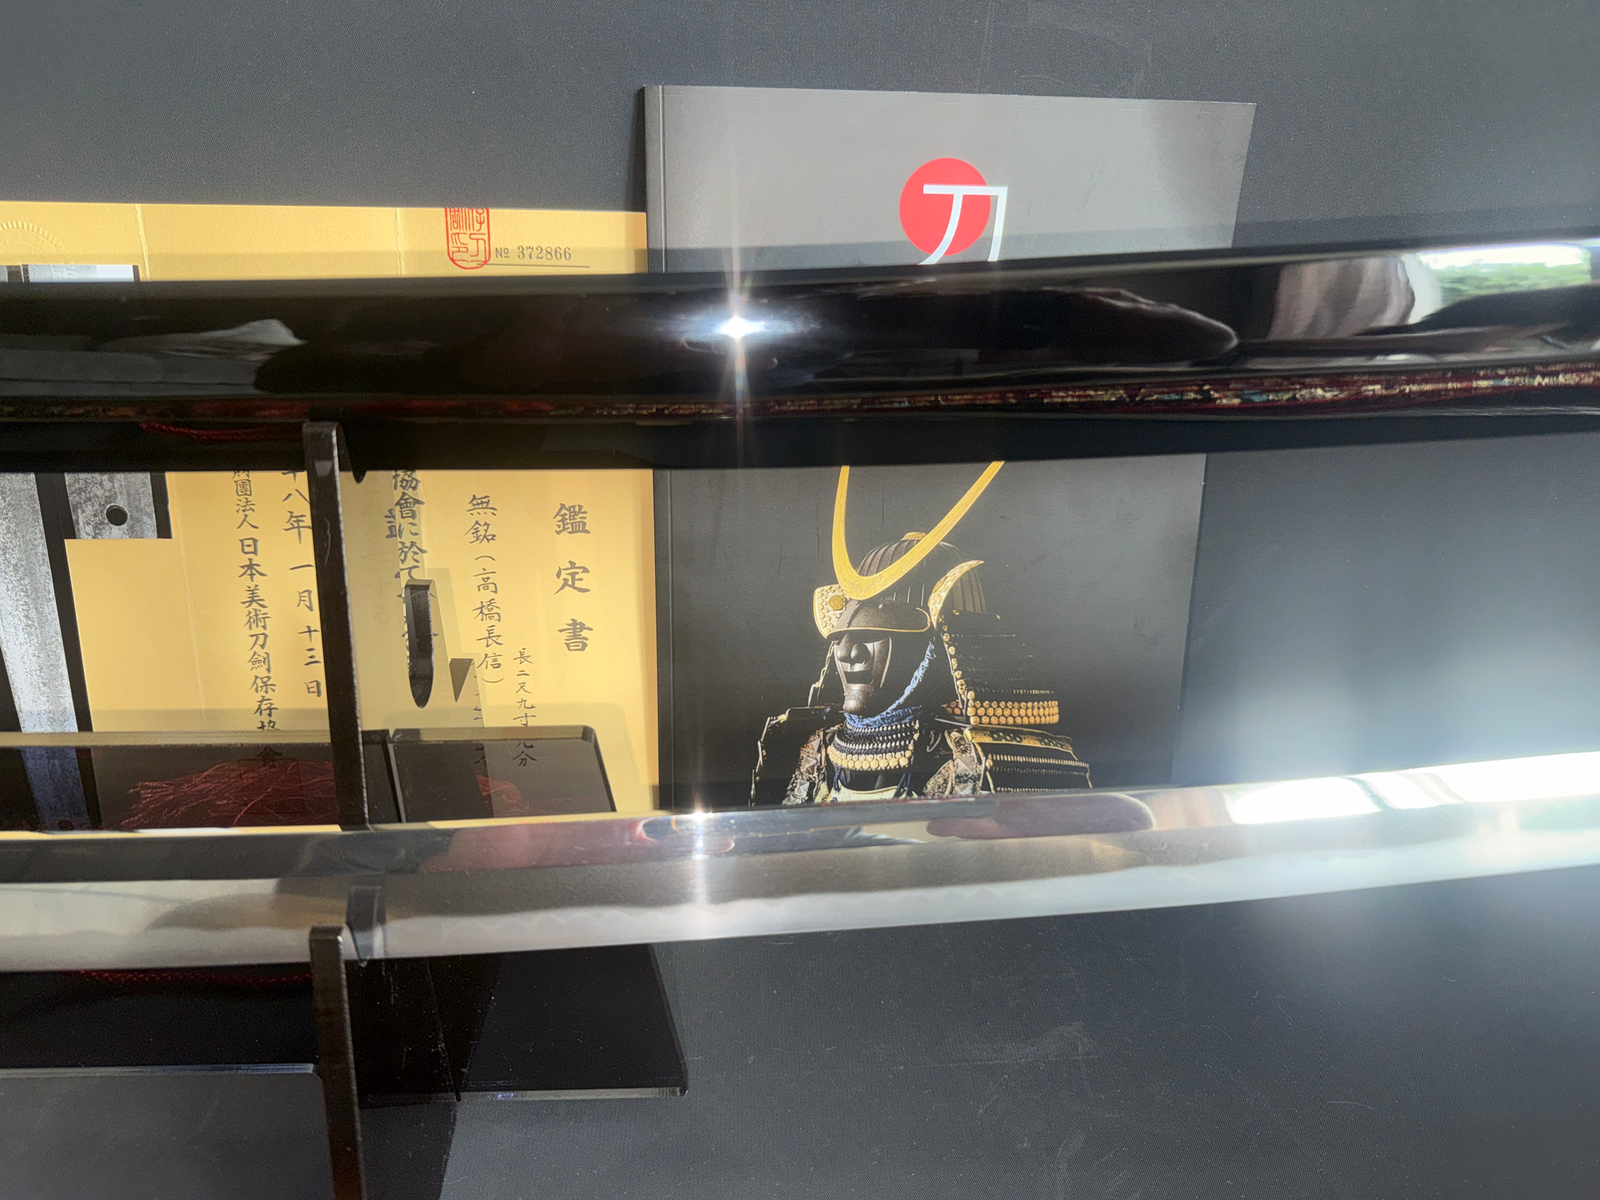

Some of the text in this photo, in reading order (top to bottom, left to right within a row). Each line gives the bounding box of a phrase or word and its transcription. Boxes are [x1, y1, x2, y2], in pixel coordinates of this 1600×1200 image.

[517, 245, 572, 261] 372866
[917, 184, 1008, 265] 刀
[553, 502, 593, 652] 鑑定書
